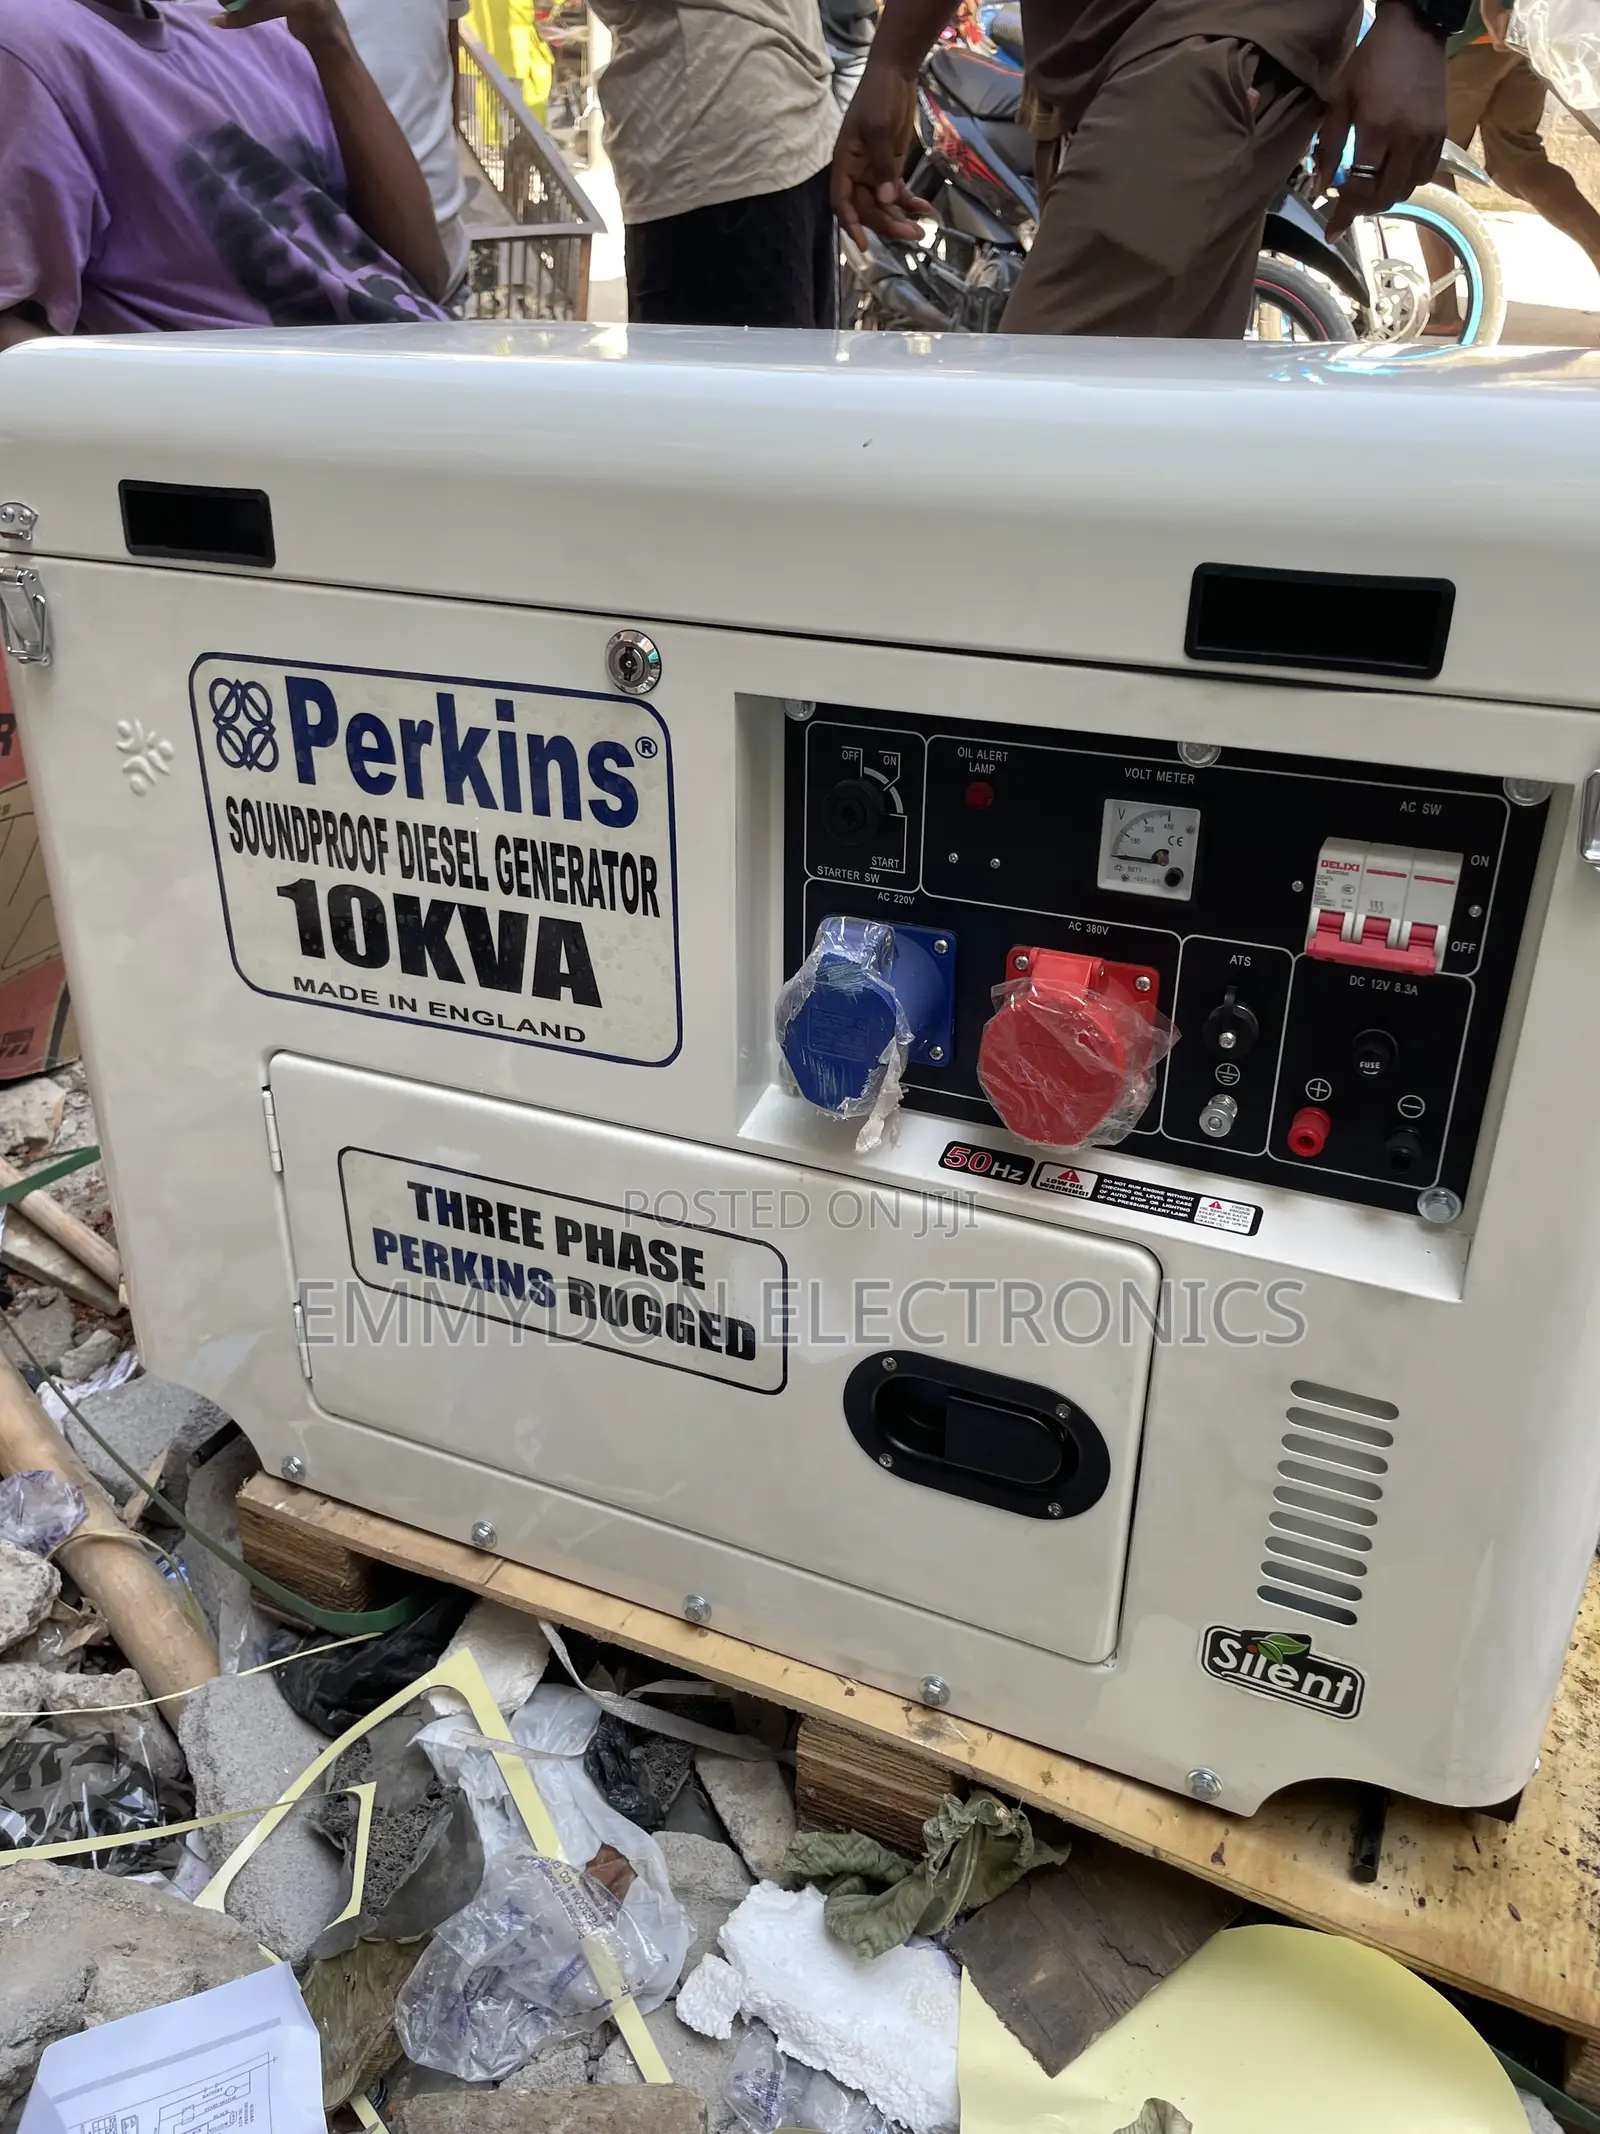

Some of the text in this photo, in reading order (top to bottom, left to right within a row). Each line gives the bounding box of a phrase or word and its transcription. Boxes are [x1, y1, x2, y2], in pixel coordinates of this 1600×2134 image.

[841, 750, 860, 762] OFF
[883, 754, 897, 767] ON
[957, 747, 1009, 763] OIL ALERT
[968, 762, 996, 775] LAMP
[1124, 767, 1195, 785] VOLT METER
[1118, 807, 1126, 820] V
[1400, 800, 1443, 816] AC SW
[225, 796, 660, 918] SOUNDPROOF DIESEL GENERATOR
[871, 856, 900, 870] START
[1470, 854, 1489, 868] ON
[1321, 859, 1360, 872] DELIXI
[817, 866, 880, 884] STARTER SW
[877, 892, 915, 905] AC 220V
[1068, 921, 1110, 936] AC 380V
[276, 878, 603, 1009] 10KVA
[1451, 941, 1476, 955] OFF
[1229, 954, 1251, 968] ATS
[1349, 974, 1419, 996] DC 12V 8.3A
[293, 976, 587, 1043] MADE IN ENGLAND
[1359, 1061, 1381, 1070] FUSE
[1040, 1181, 1090, 1197] WARNING!
[1046, 1177, 1068, 1187] LOW
[1110, 1191, 1127, 1199] AUTO
[1162, 1203, 1191, 1213] LIGHTING
[1142, 1186, 1165, 1196] ENGINE
[1166, 1191, 1195, 1202] WITHOUT
[1145, 1193, 1165, 1201] LEVEL
[1175, 1199, 1193, 1207] CASE
[1116, 1198, 1149, 1210] PRESSURE
[1149, 1205, 1170, 1214] ALERT
[407, 1180, 706, 1291] THREE PHASE
[372, 1227, 757, 1361] PERKINS RUGGED
[1212, 1637, 1354, 1704] Silent
